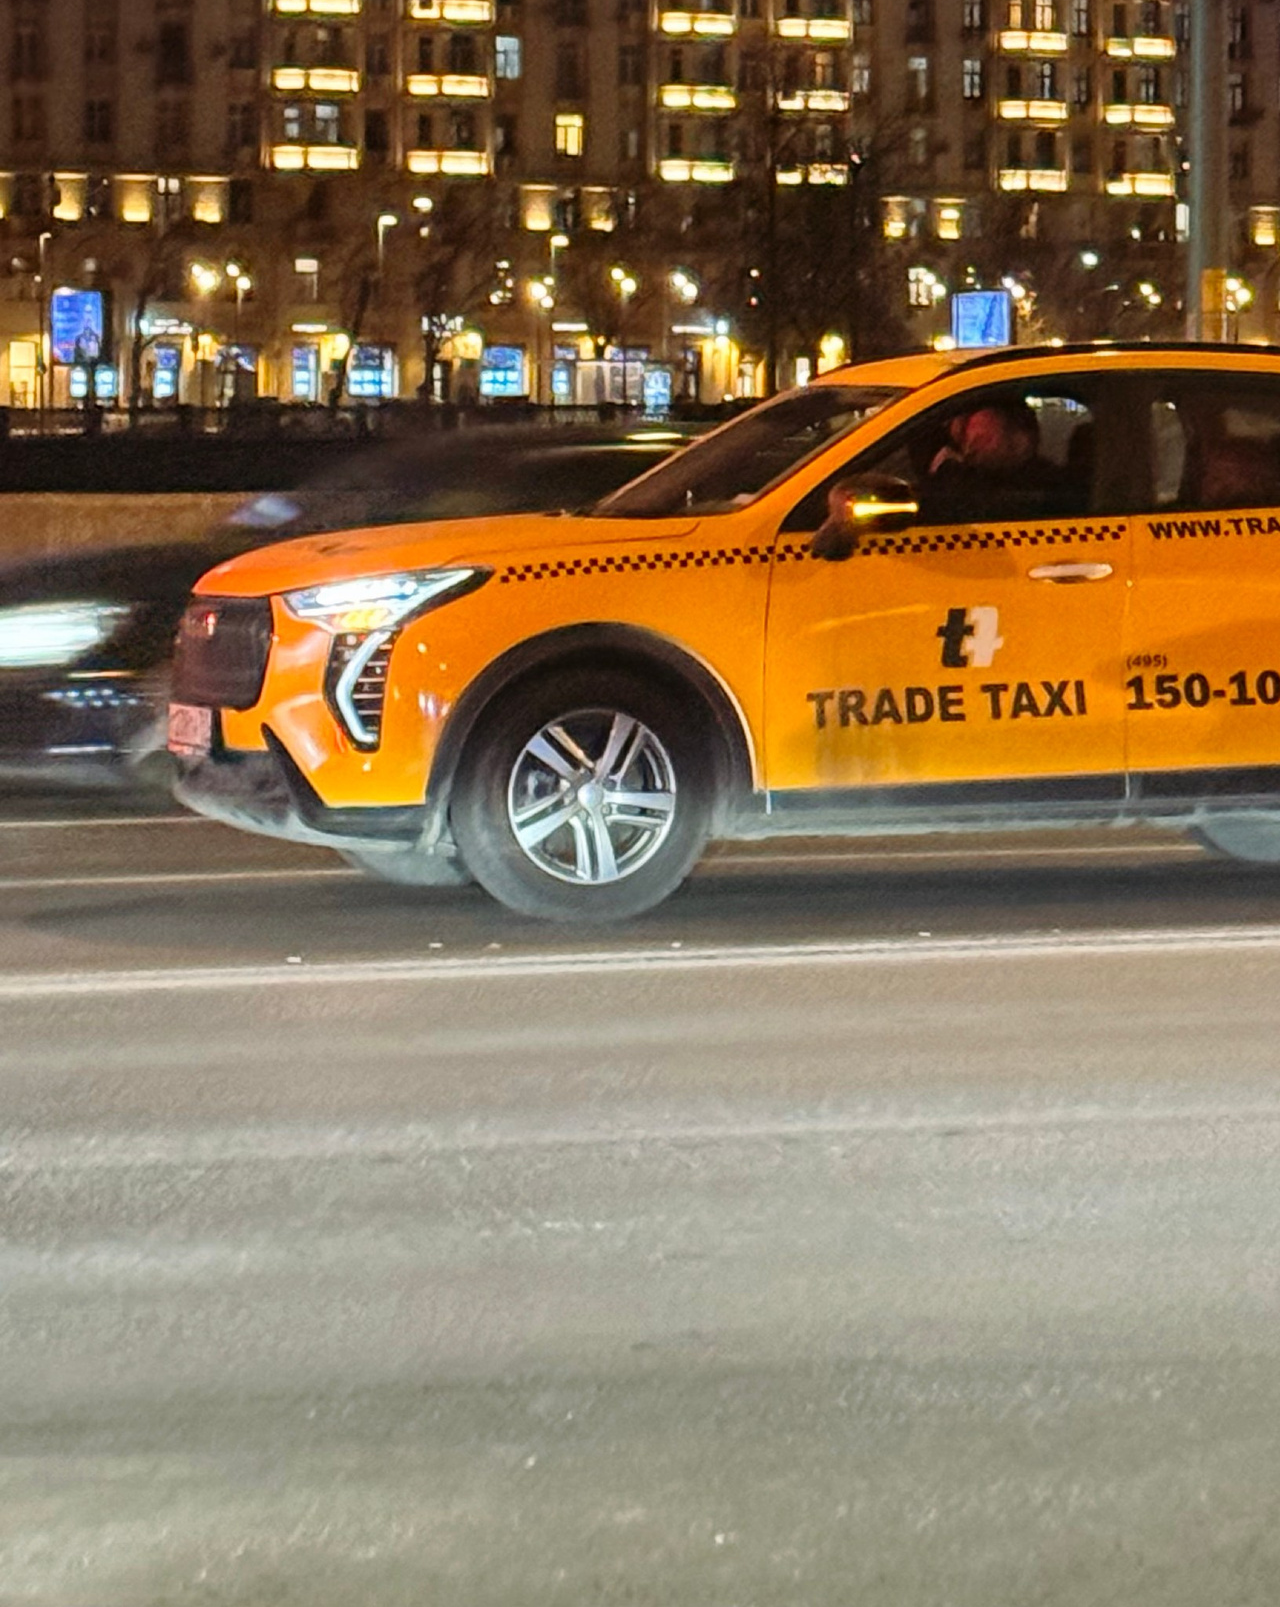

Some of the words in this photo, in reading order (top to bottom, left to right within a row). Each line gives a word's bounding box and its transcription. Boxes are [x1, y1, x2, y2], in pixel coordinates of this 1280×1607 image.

[1126, 654, 1168, 670] (495)
[806, 684, 966, 730] TRADE
[981, 680, 1087, 719] TAXI
